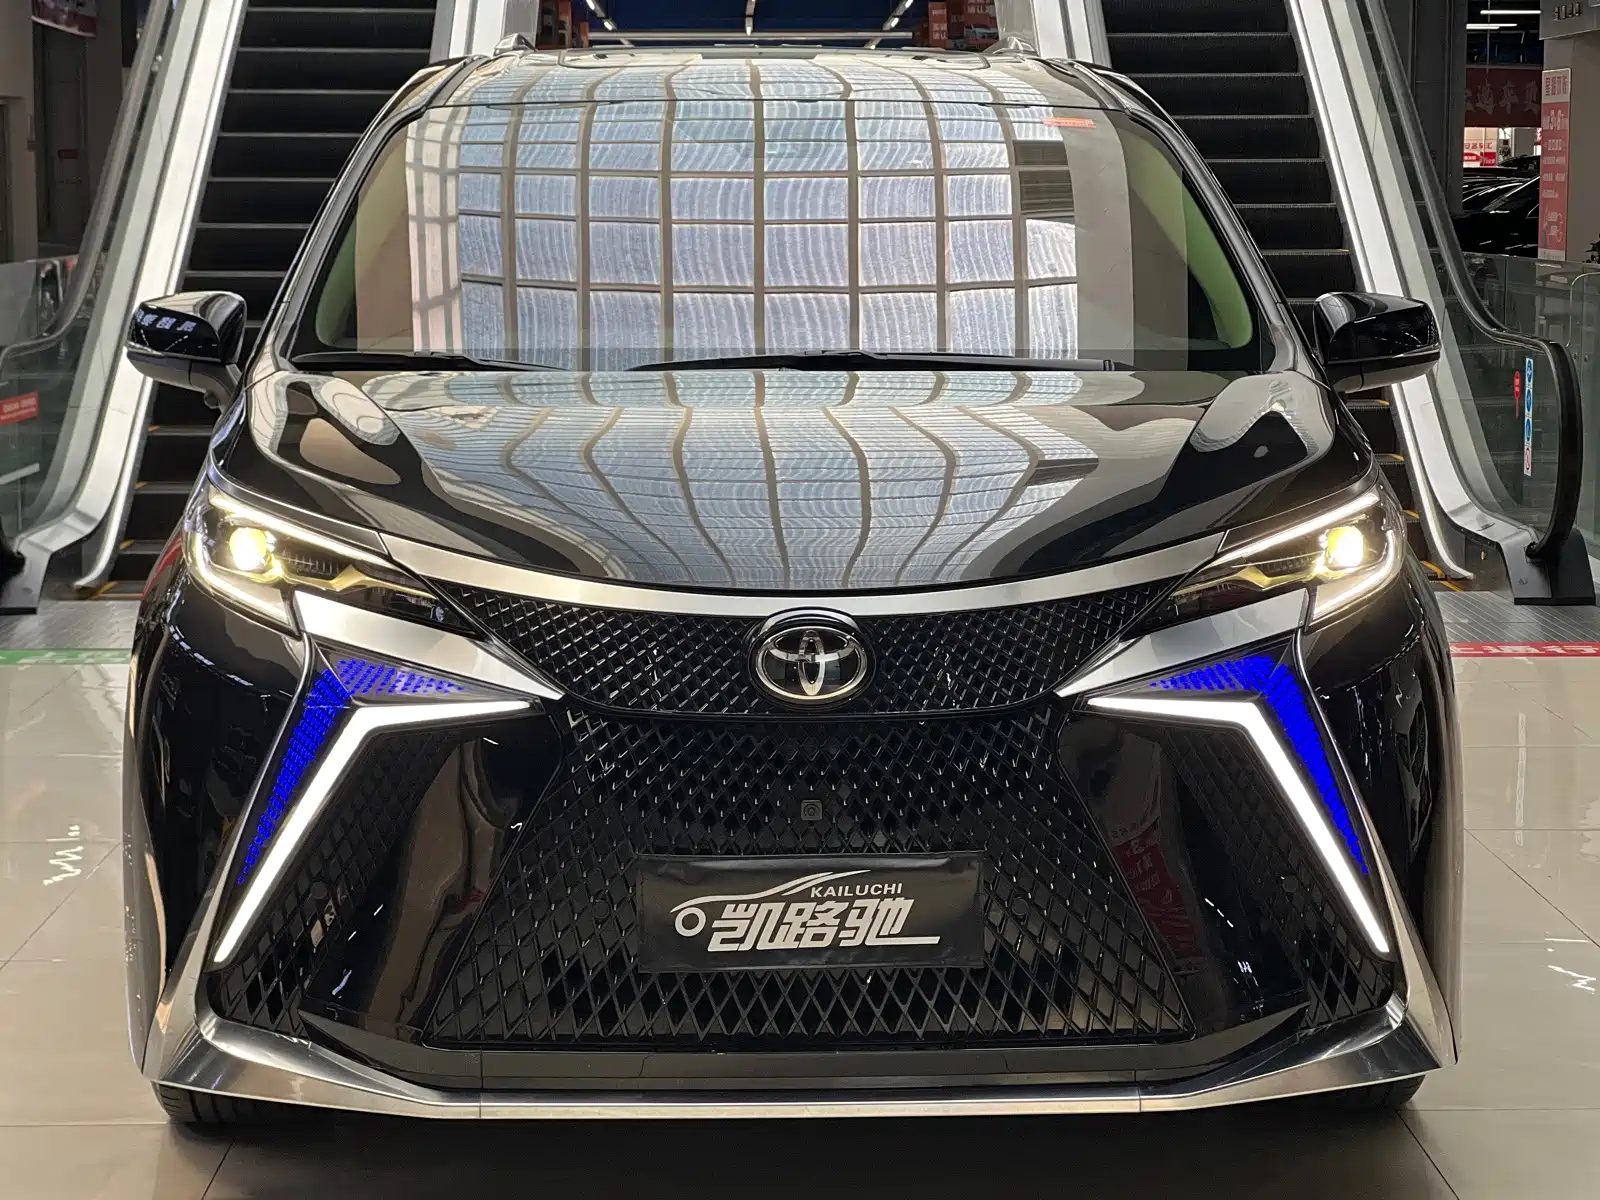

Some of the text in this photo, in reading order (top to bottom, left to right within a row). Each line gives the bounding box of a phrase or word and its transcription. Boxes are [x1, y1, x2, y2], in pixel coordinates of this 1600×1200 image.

[810, 883, 902, 898] KAILUCHI
[708, 898, 940, 952] 凯路驰
